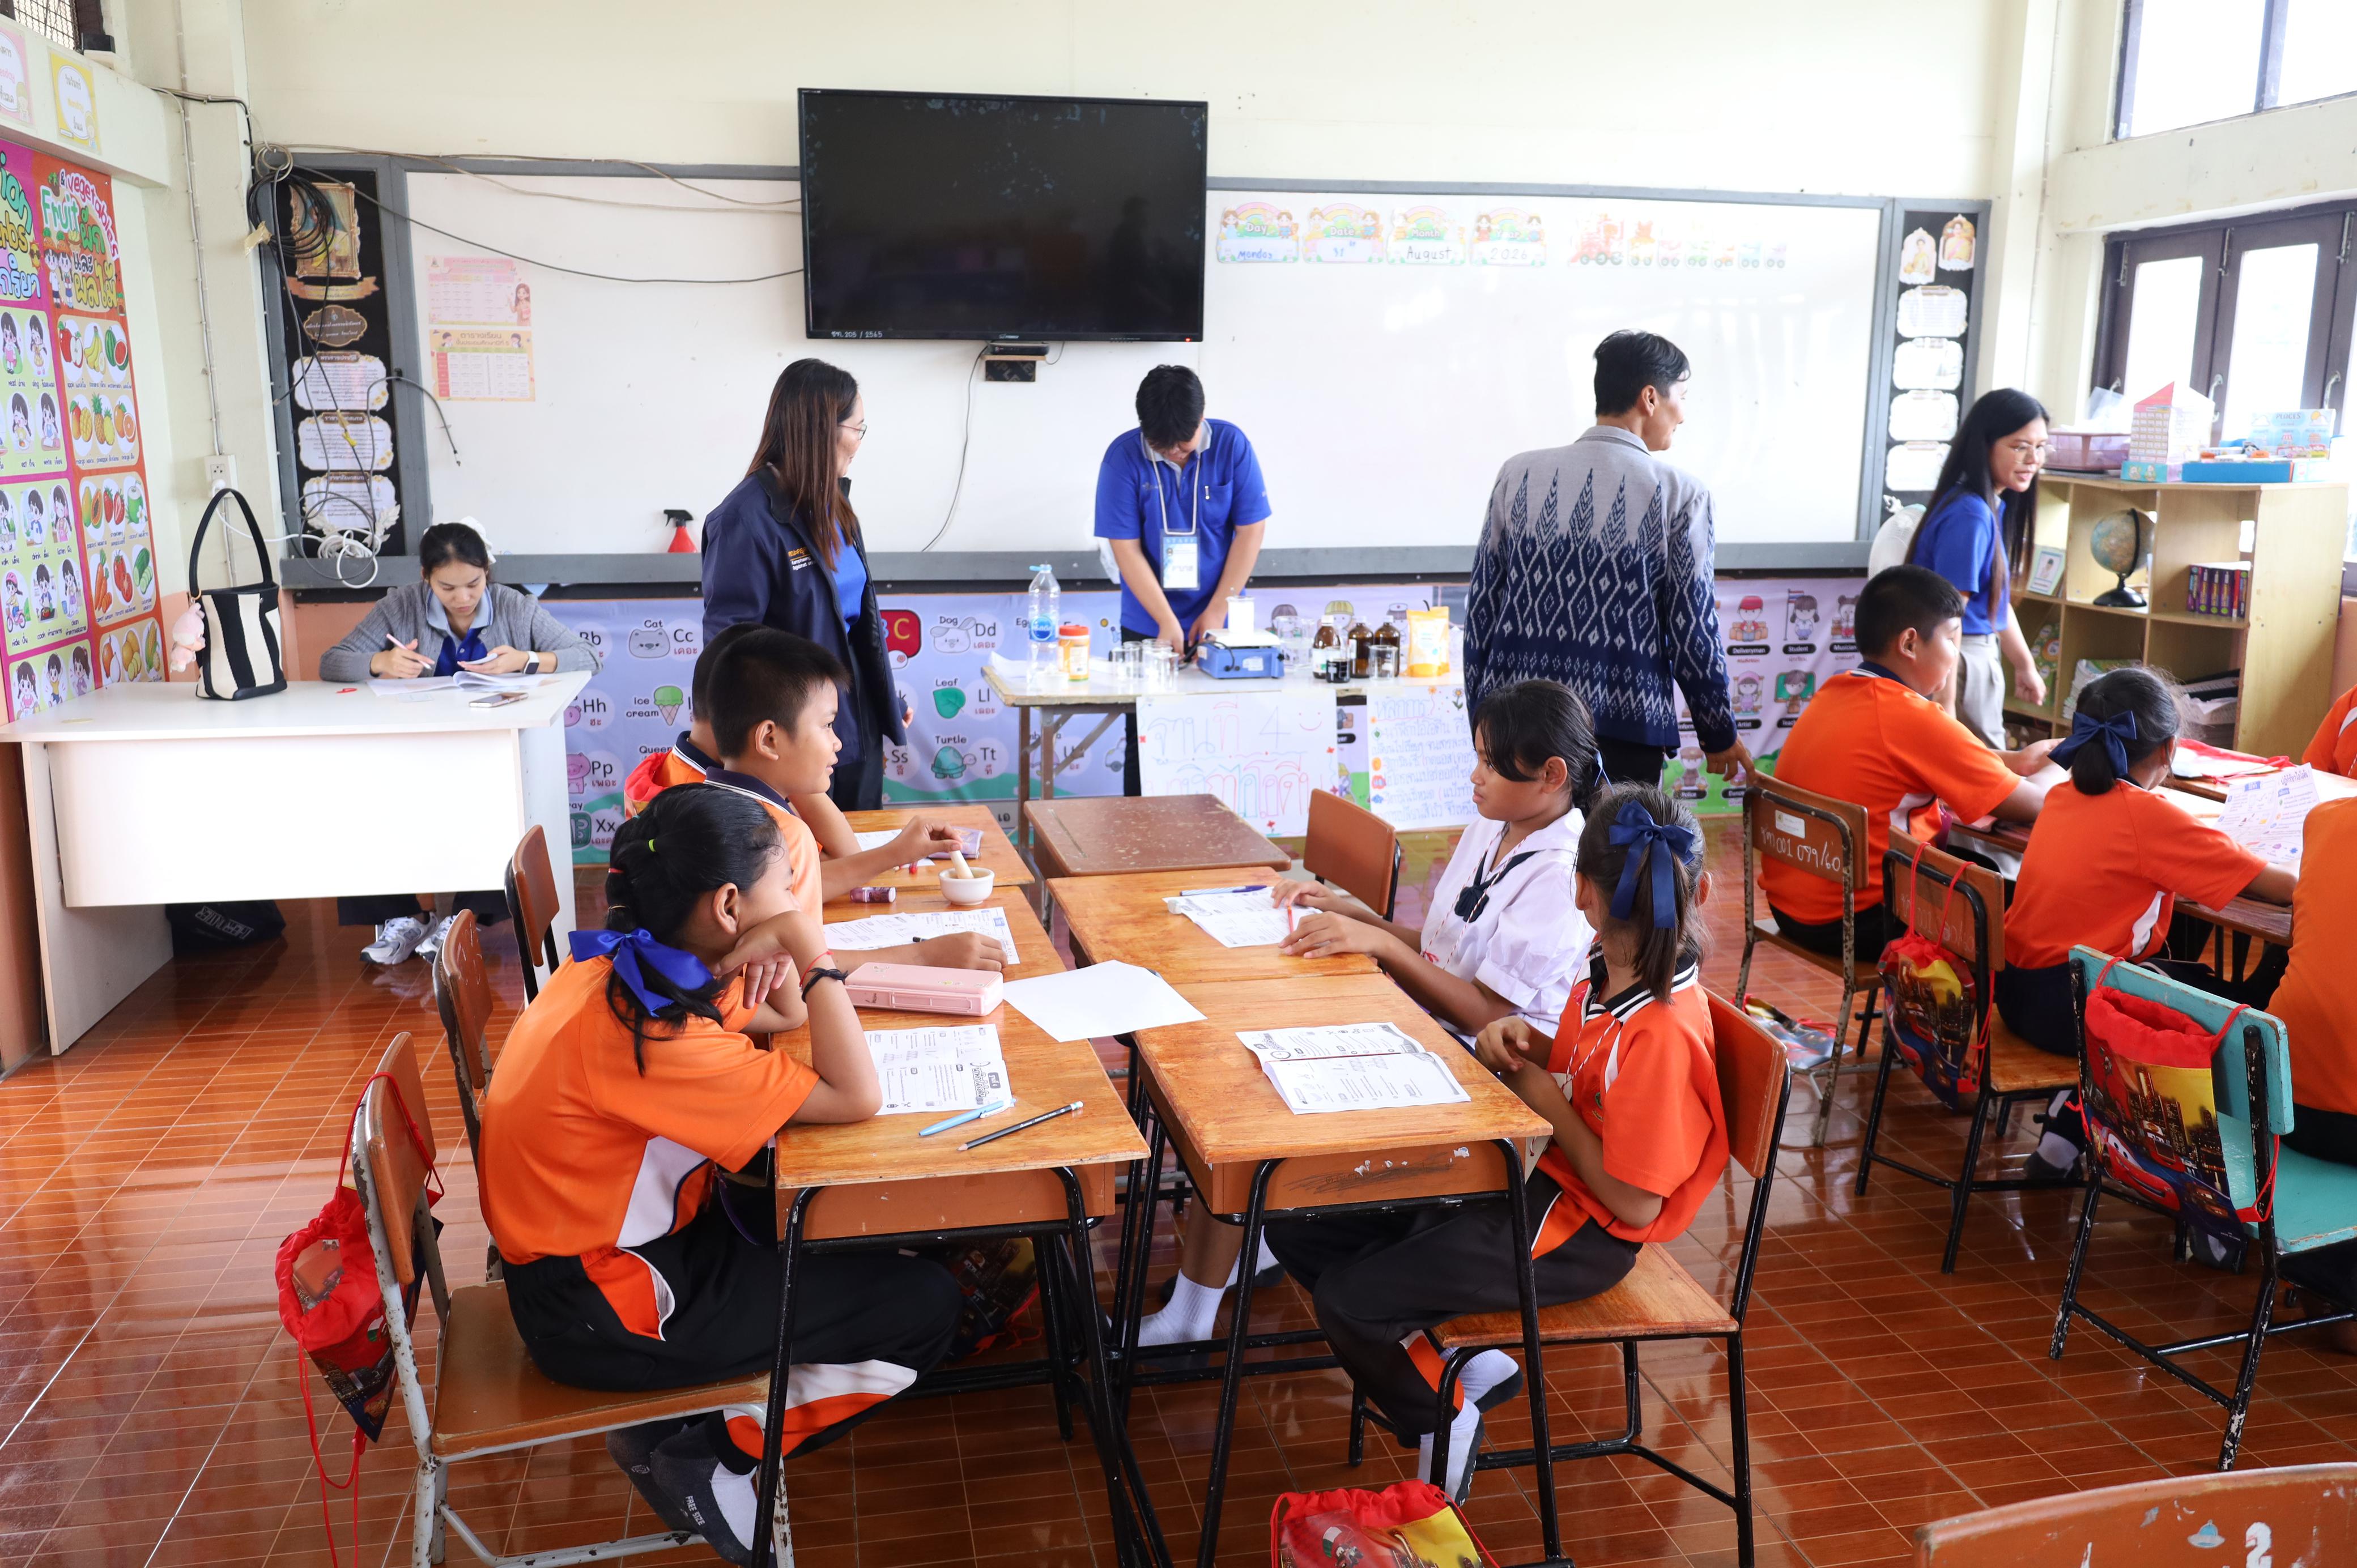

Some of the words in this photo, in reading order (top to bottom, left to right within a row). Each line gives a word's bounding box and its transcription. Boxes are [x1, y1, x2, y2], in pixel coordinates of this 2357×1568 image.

[41, 189, 79, 230] Fruit
[60, 172, 66, 186] &
[67, 174, 118, 257] vegetables
[0, 210, 28, 253] rbs
[80, 205, 105, 254] ผัก
[1247, 222, 1267, 235] Day
[1330, 227, 1355, 236] Date
[1412, 229, 1440, 237] Month
[1496, 229, 1520, 238] Yar
[1407, 246, 1452, 262] August
[74, 254, 93, 272] และ
[74, 259, 117, 308] ผลไม้
[644, 620, 663, 628] Cat
[940, 616, 958, 625] Dog
[1016, 618, 1029, 628] Eg
[674, 629, 694, 642] Cc
[894, 618, 910, 640] C
[976, 623, 996, 637] Dd
[979, 688, 990, 702] Ll
[584, 698, 606, 713] Hh
[1260, 706, 1291, 748] 4
[935, 735, 967, 744] Turtle
[892, 749, 908, 764] Ss
[980, 748, 997, 760] Tt
[592, 761, 613, 777] Pp
[596, 819, 615, 833] Xx
[685, 1495, 697, 1512] FREE
[692, 1511, 705, 1526] SIZE
